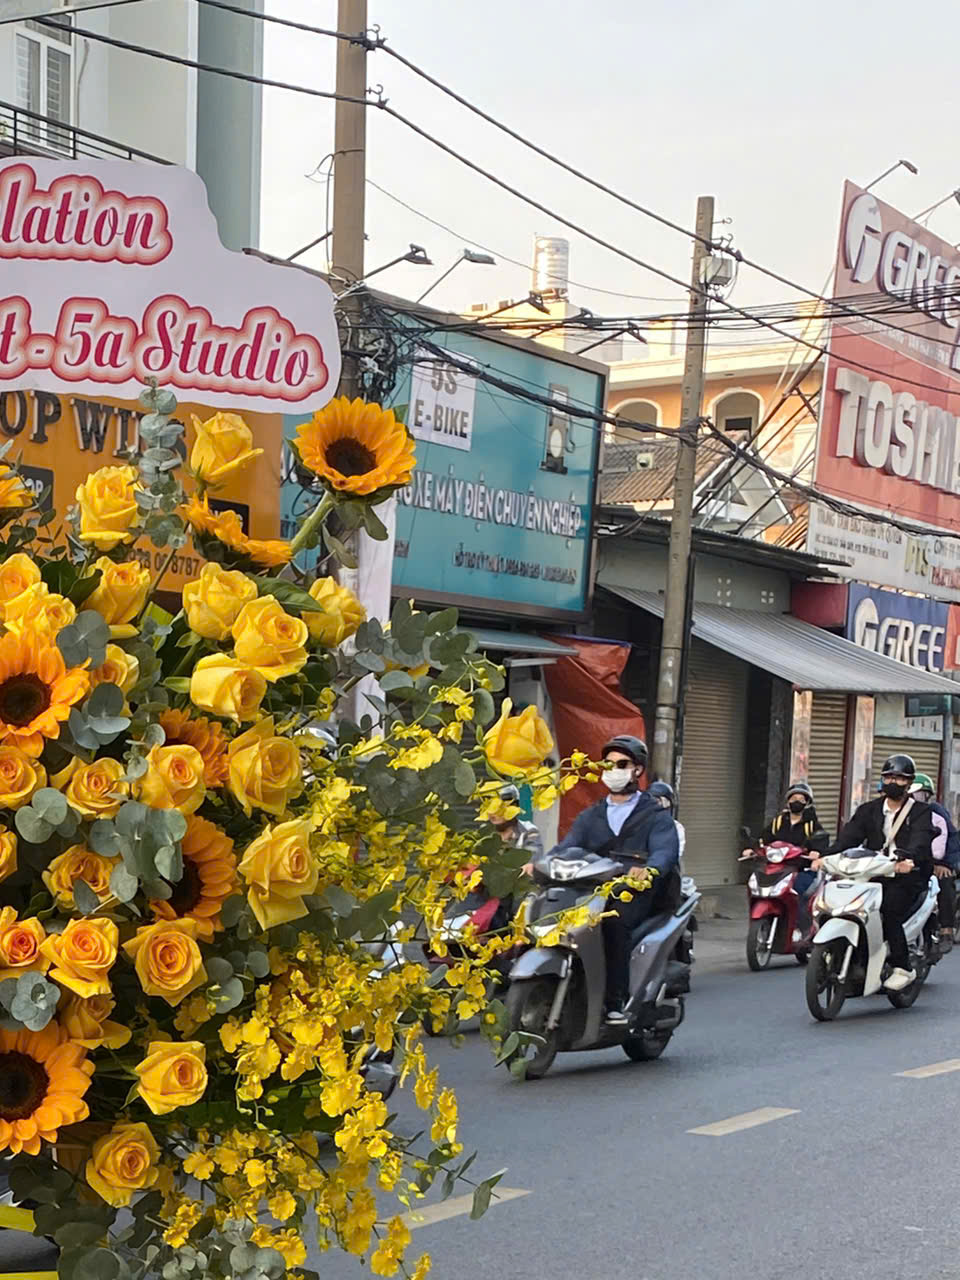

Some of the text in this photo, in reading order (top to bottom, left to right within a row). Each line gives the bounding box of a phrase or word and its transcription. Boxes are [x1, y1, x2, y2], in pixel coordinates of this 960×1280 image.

[64, 312, 128, 368] 5a
[142, 310, 315, 388] Studio
[415, 470, 432, 509] XE
[433, 464, 465, 515] MÁY
[464, 472, 493, 532] ĐIỆN
[878, 616, 946, 672] GREE
